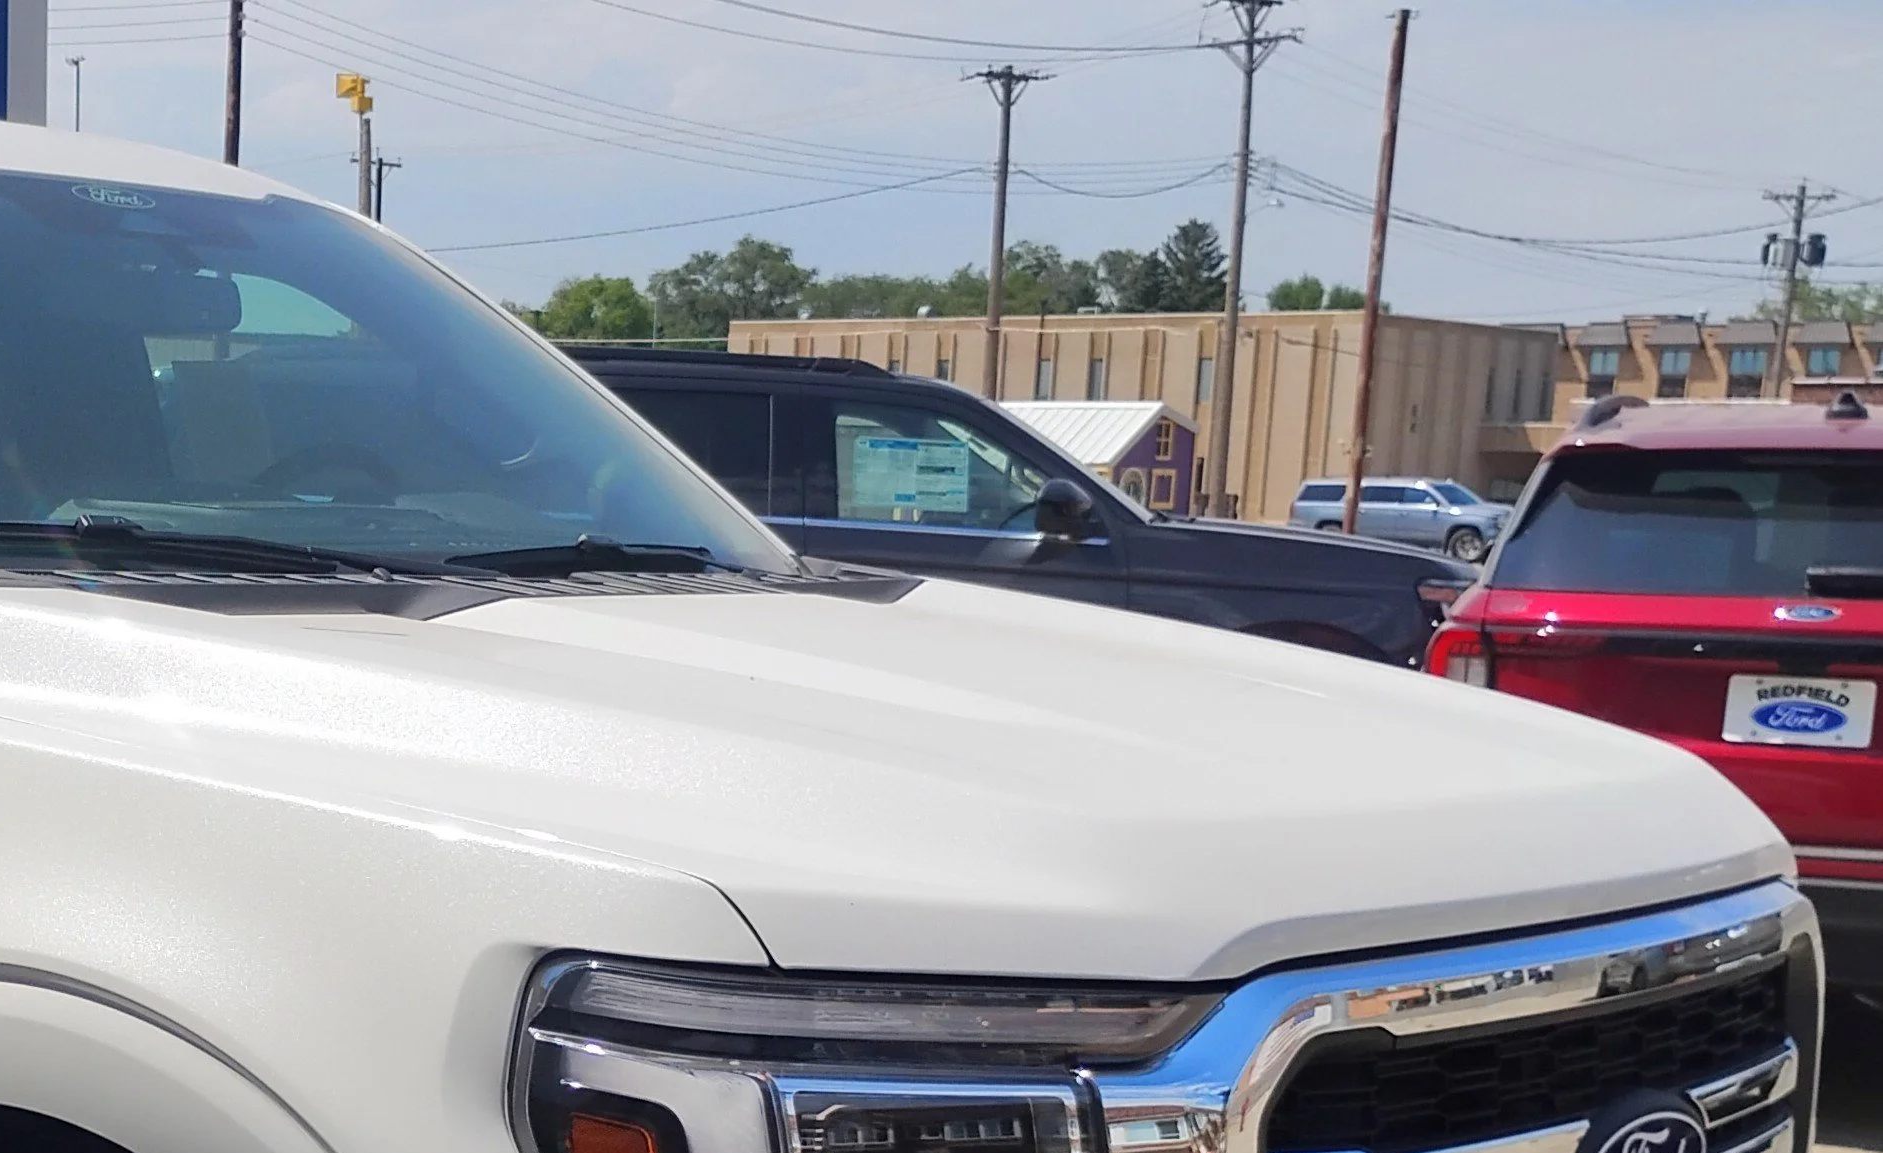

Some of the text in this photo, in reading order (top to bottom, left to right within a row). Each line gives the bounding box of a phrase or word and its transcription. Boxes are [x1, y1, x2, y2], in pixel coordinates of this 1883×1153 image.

[88, 186, 143, 206] Ford
[1756, 685, 1851, 708] REDFIELD
[1768, 706, 1829, 731] Ford
